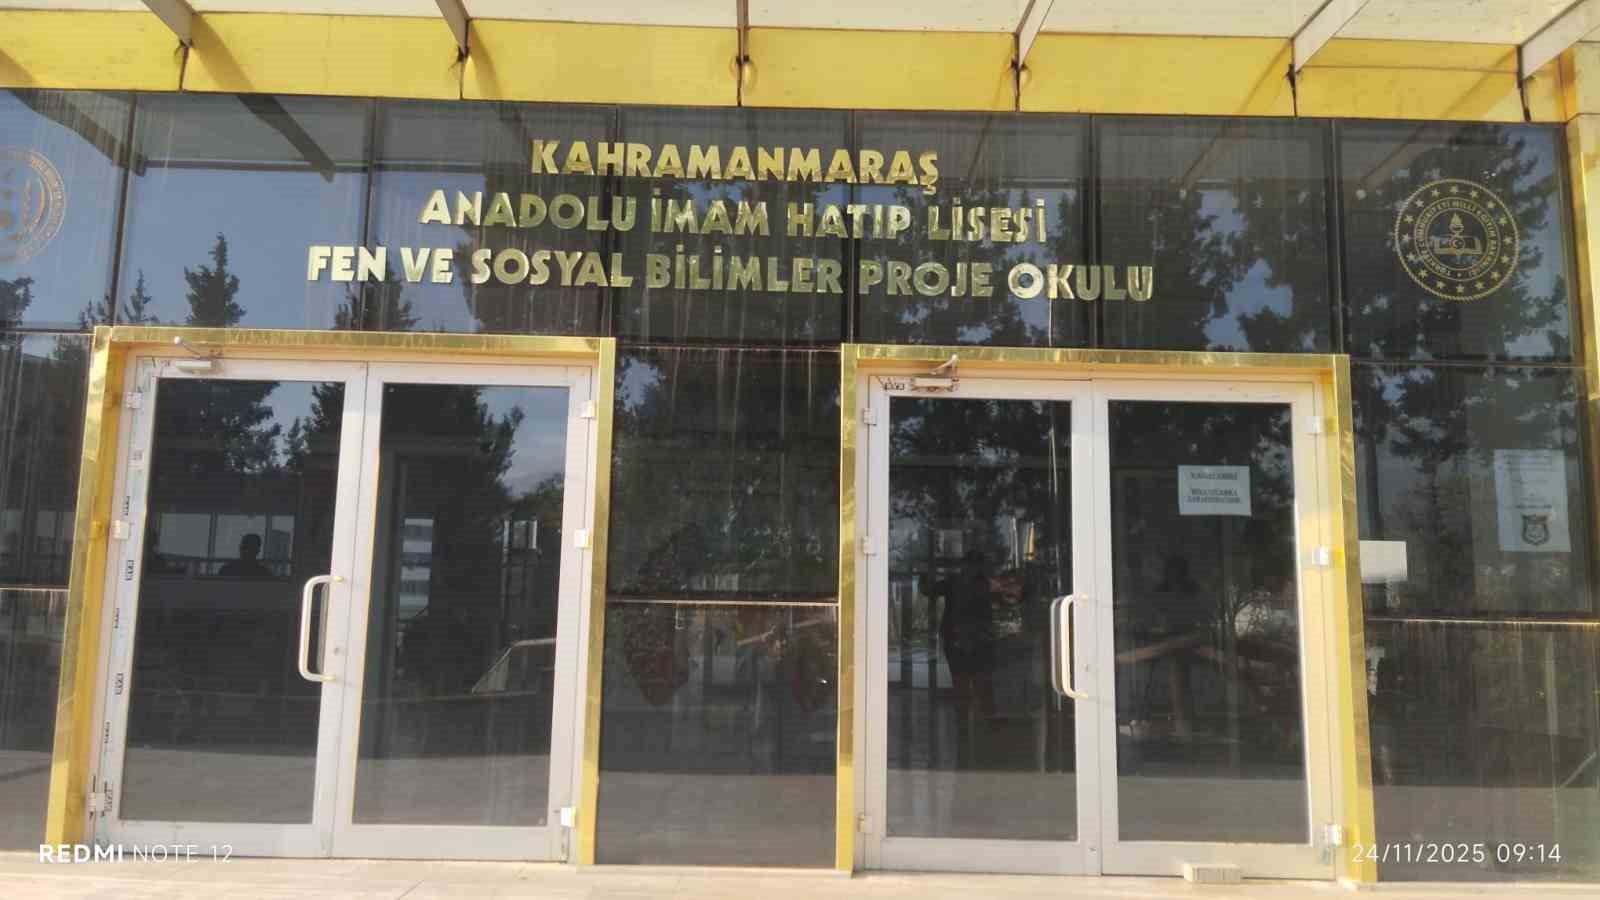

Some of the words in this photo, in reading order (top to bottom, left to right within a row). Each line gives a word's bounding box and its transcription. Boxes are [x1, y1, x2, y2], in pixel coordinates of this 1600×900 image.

[530, 139, 939, 196] KAHRAMANMARAŞ
[419, 189, 637, 232] ANADOLU
[650, 189, 769, 236] İMAM
[927, 196, 1048, 243] LİSESİ
[307, 245, 387, 282] FEN
[400, 246, 454, 285] VE
[471, 247, 634, 288] SOSYAL
[645, 242, 844, 294] BİLİMLER
[858, 258, 995, 298] PROJE
[1007, 262, 1154, 302] OKULU
